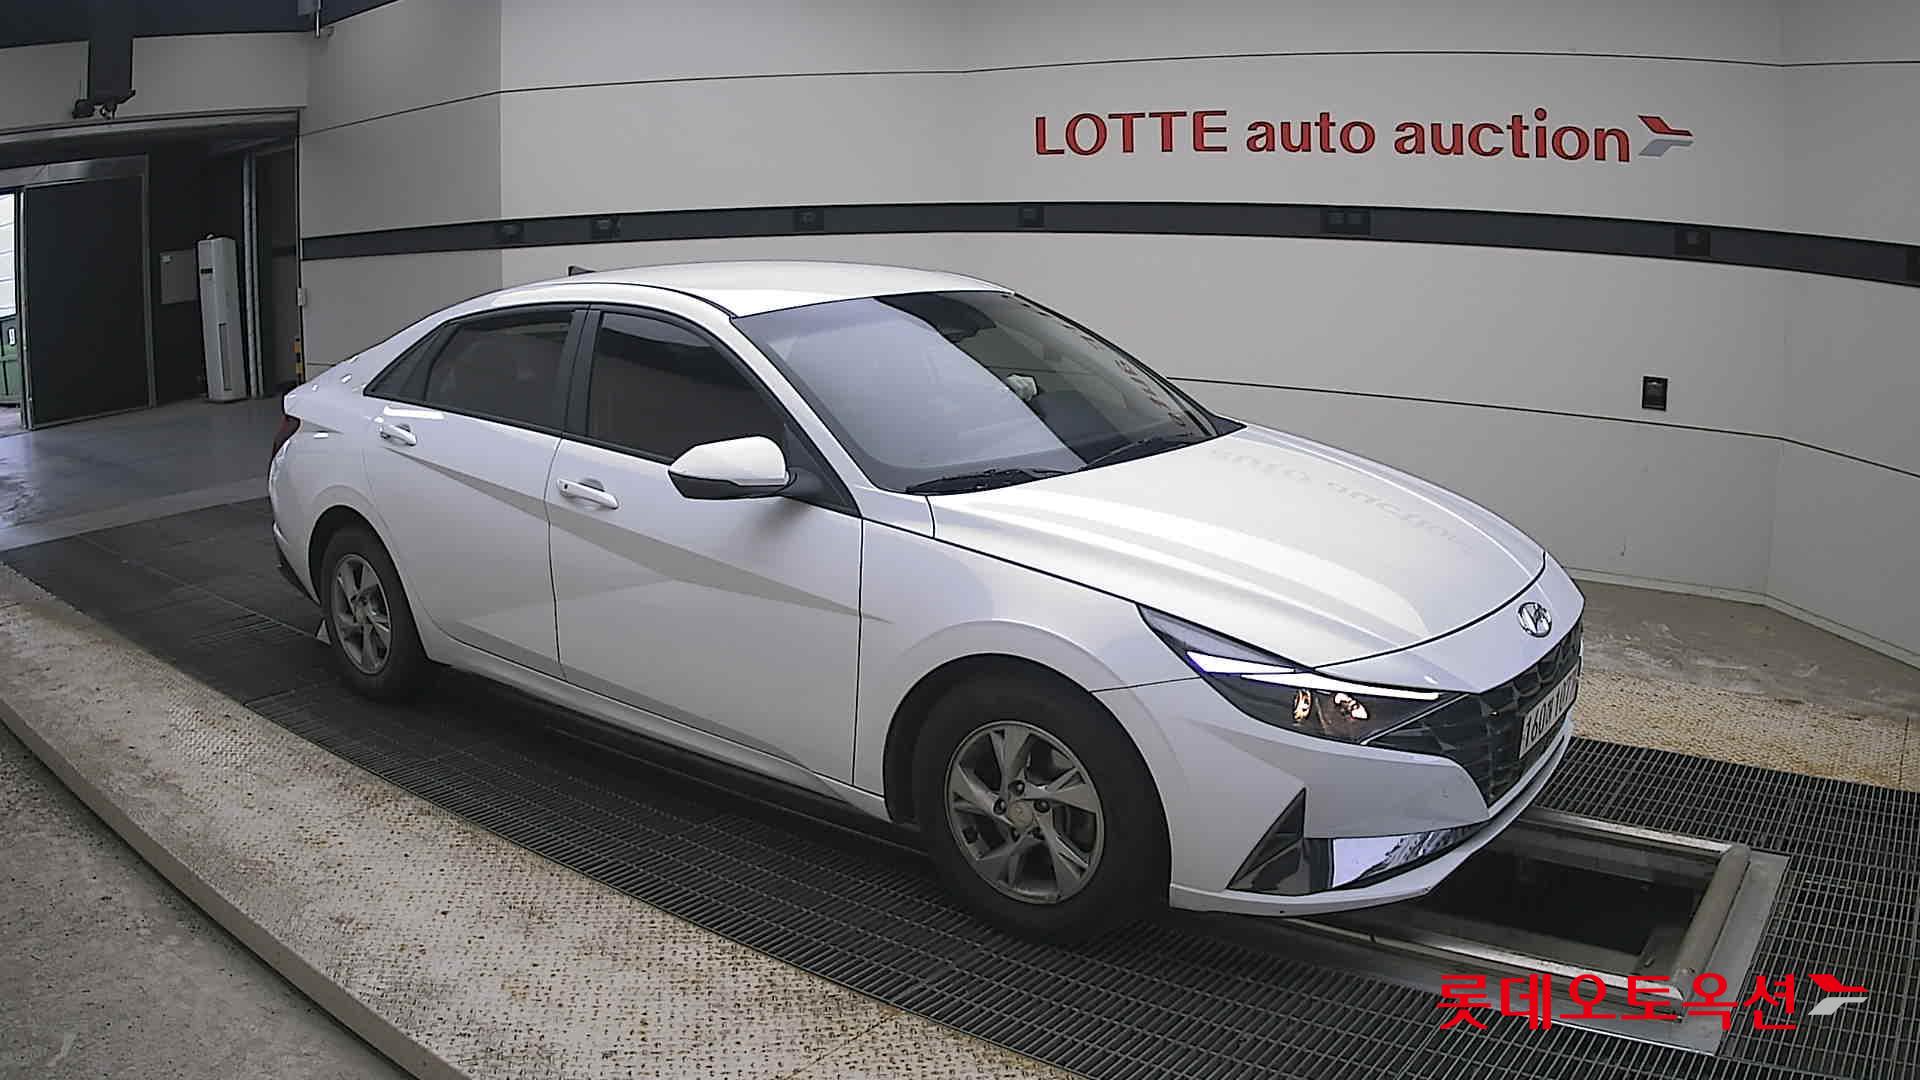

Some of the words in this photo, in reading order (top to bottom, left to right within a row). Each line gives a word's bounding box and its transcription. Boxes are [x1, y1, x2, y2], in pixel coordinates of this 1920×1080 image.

[1036, 110, 1228, 156] LOTTE
[1246, 111, 1376, 154] auto
[1395, 108, 1632, 163] auction
